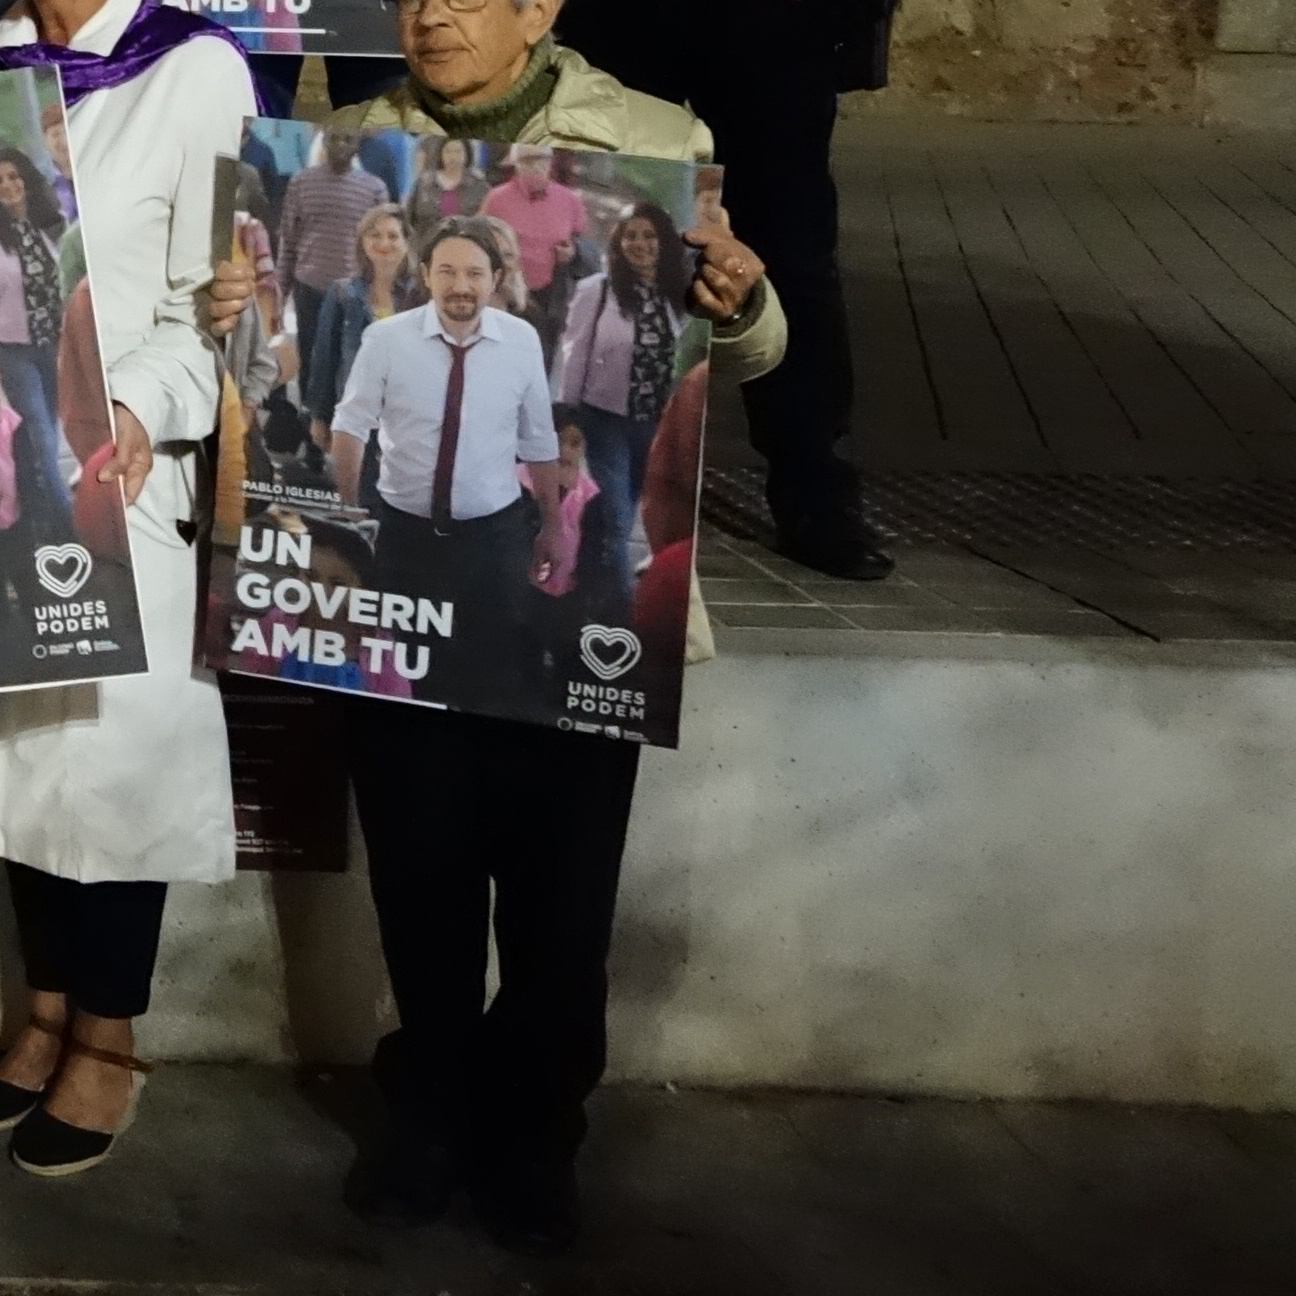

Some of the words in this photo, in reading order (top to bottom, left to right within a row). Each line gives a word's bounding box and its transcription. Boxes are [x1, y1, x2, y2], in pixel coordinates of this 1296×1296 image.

[242, 480, 283, 495] PABLO
[285, 485, 342, 503] IGLESIAS
[239, 525, 312, 569] UN
[34, 600, 107, 621] UNIDES
[235, 572, 454, 639] GOVERN
[36, 615, 110, 636] PODEM
[231, 619, 346, 667] AMB
[361, 636, 430, 680] TU
[568, 680, 646, 705] UNIDES
[567, 695, 645, 720] PODEM
